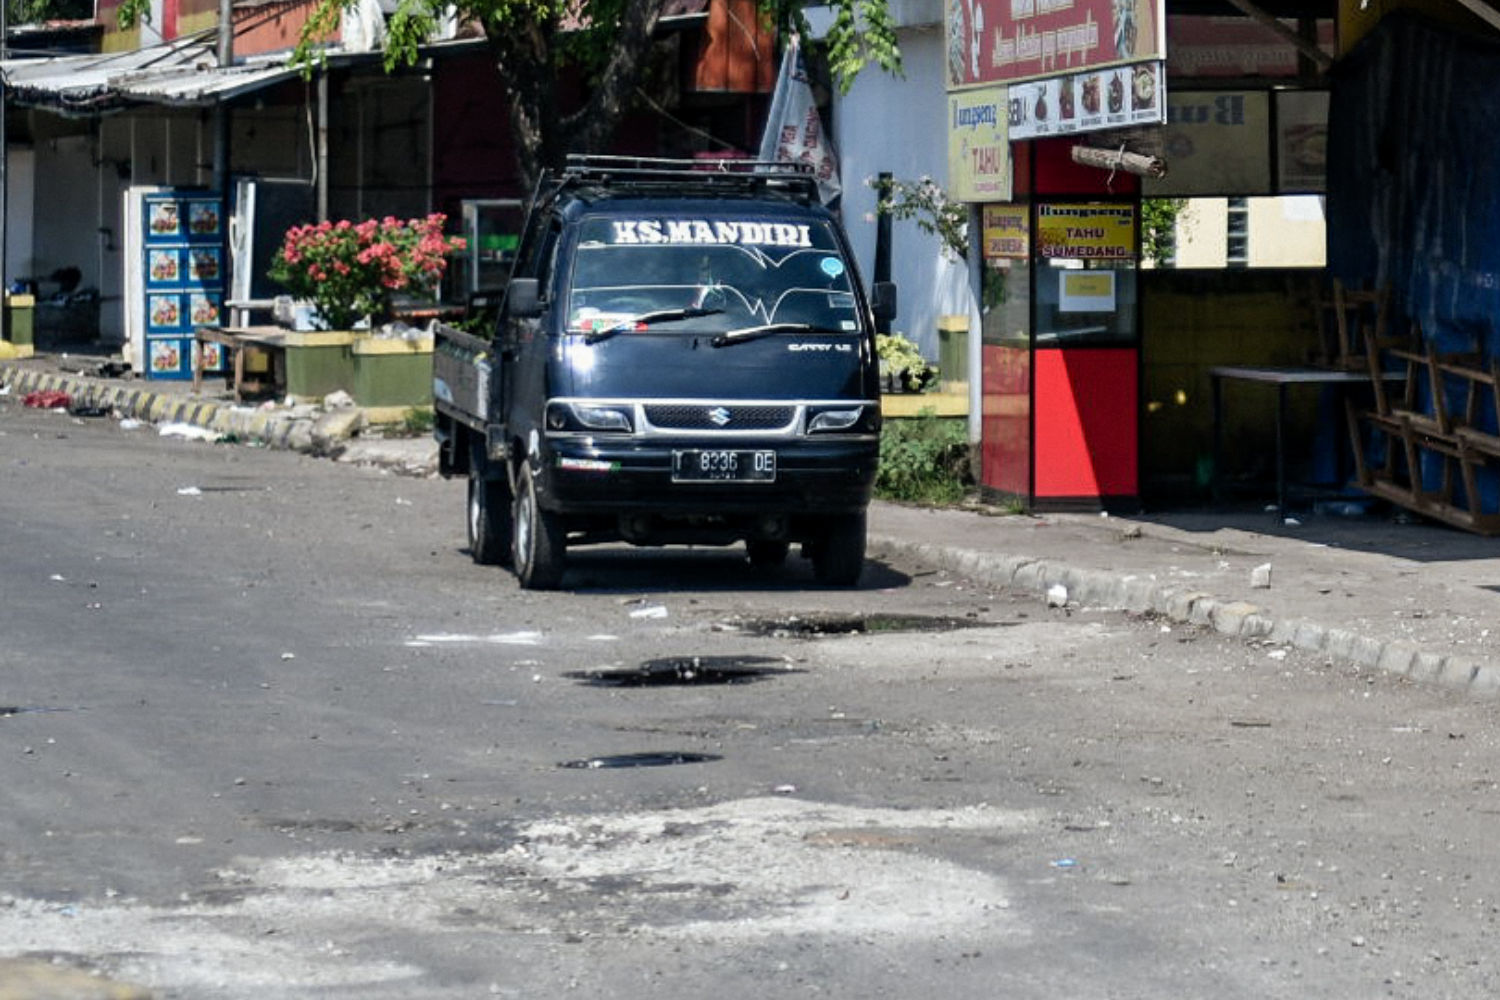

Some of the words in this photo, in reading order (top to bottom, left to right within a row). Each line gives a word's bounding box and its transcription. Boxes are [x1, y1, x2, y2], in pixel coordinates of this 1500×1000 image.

[972, 146, 999, 175] TAHU
[1066, 227, 1105, 239] TAHU
[1041, 245, 1126, 258] SUMEDANG
[754, 452, 774, 472] DE
